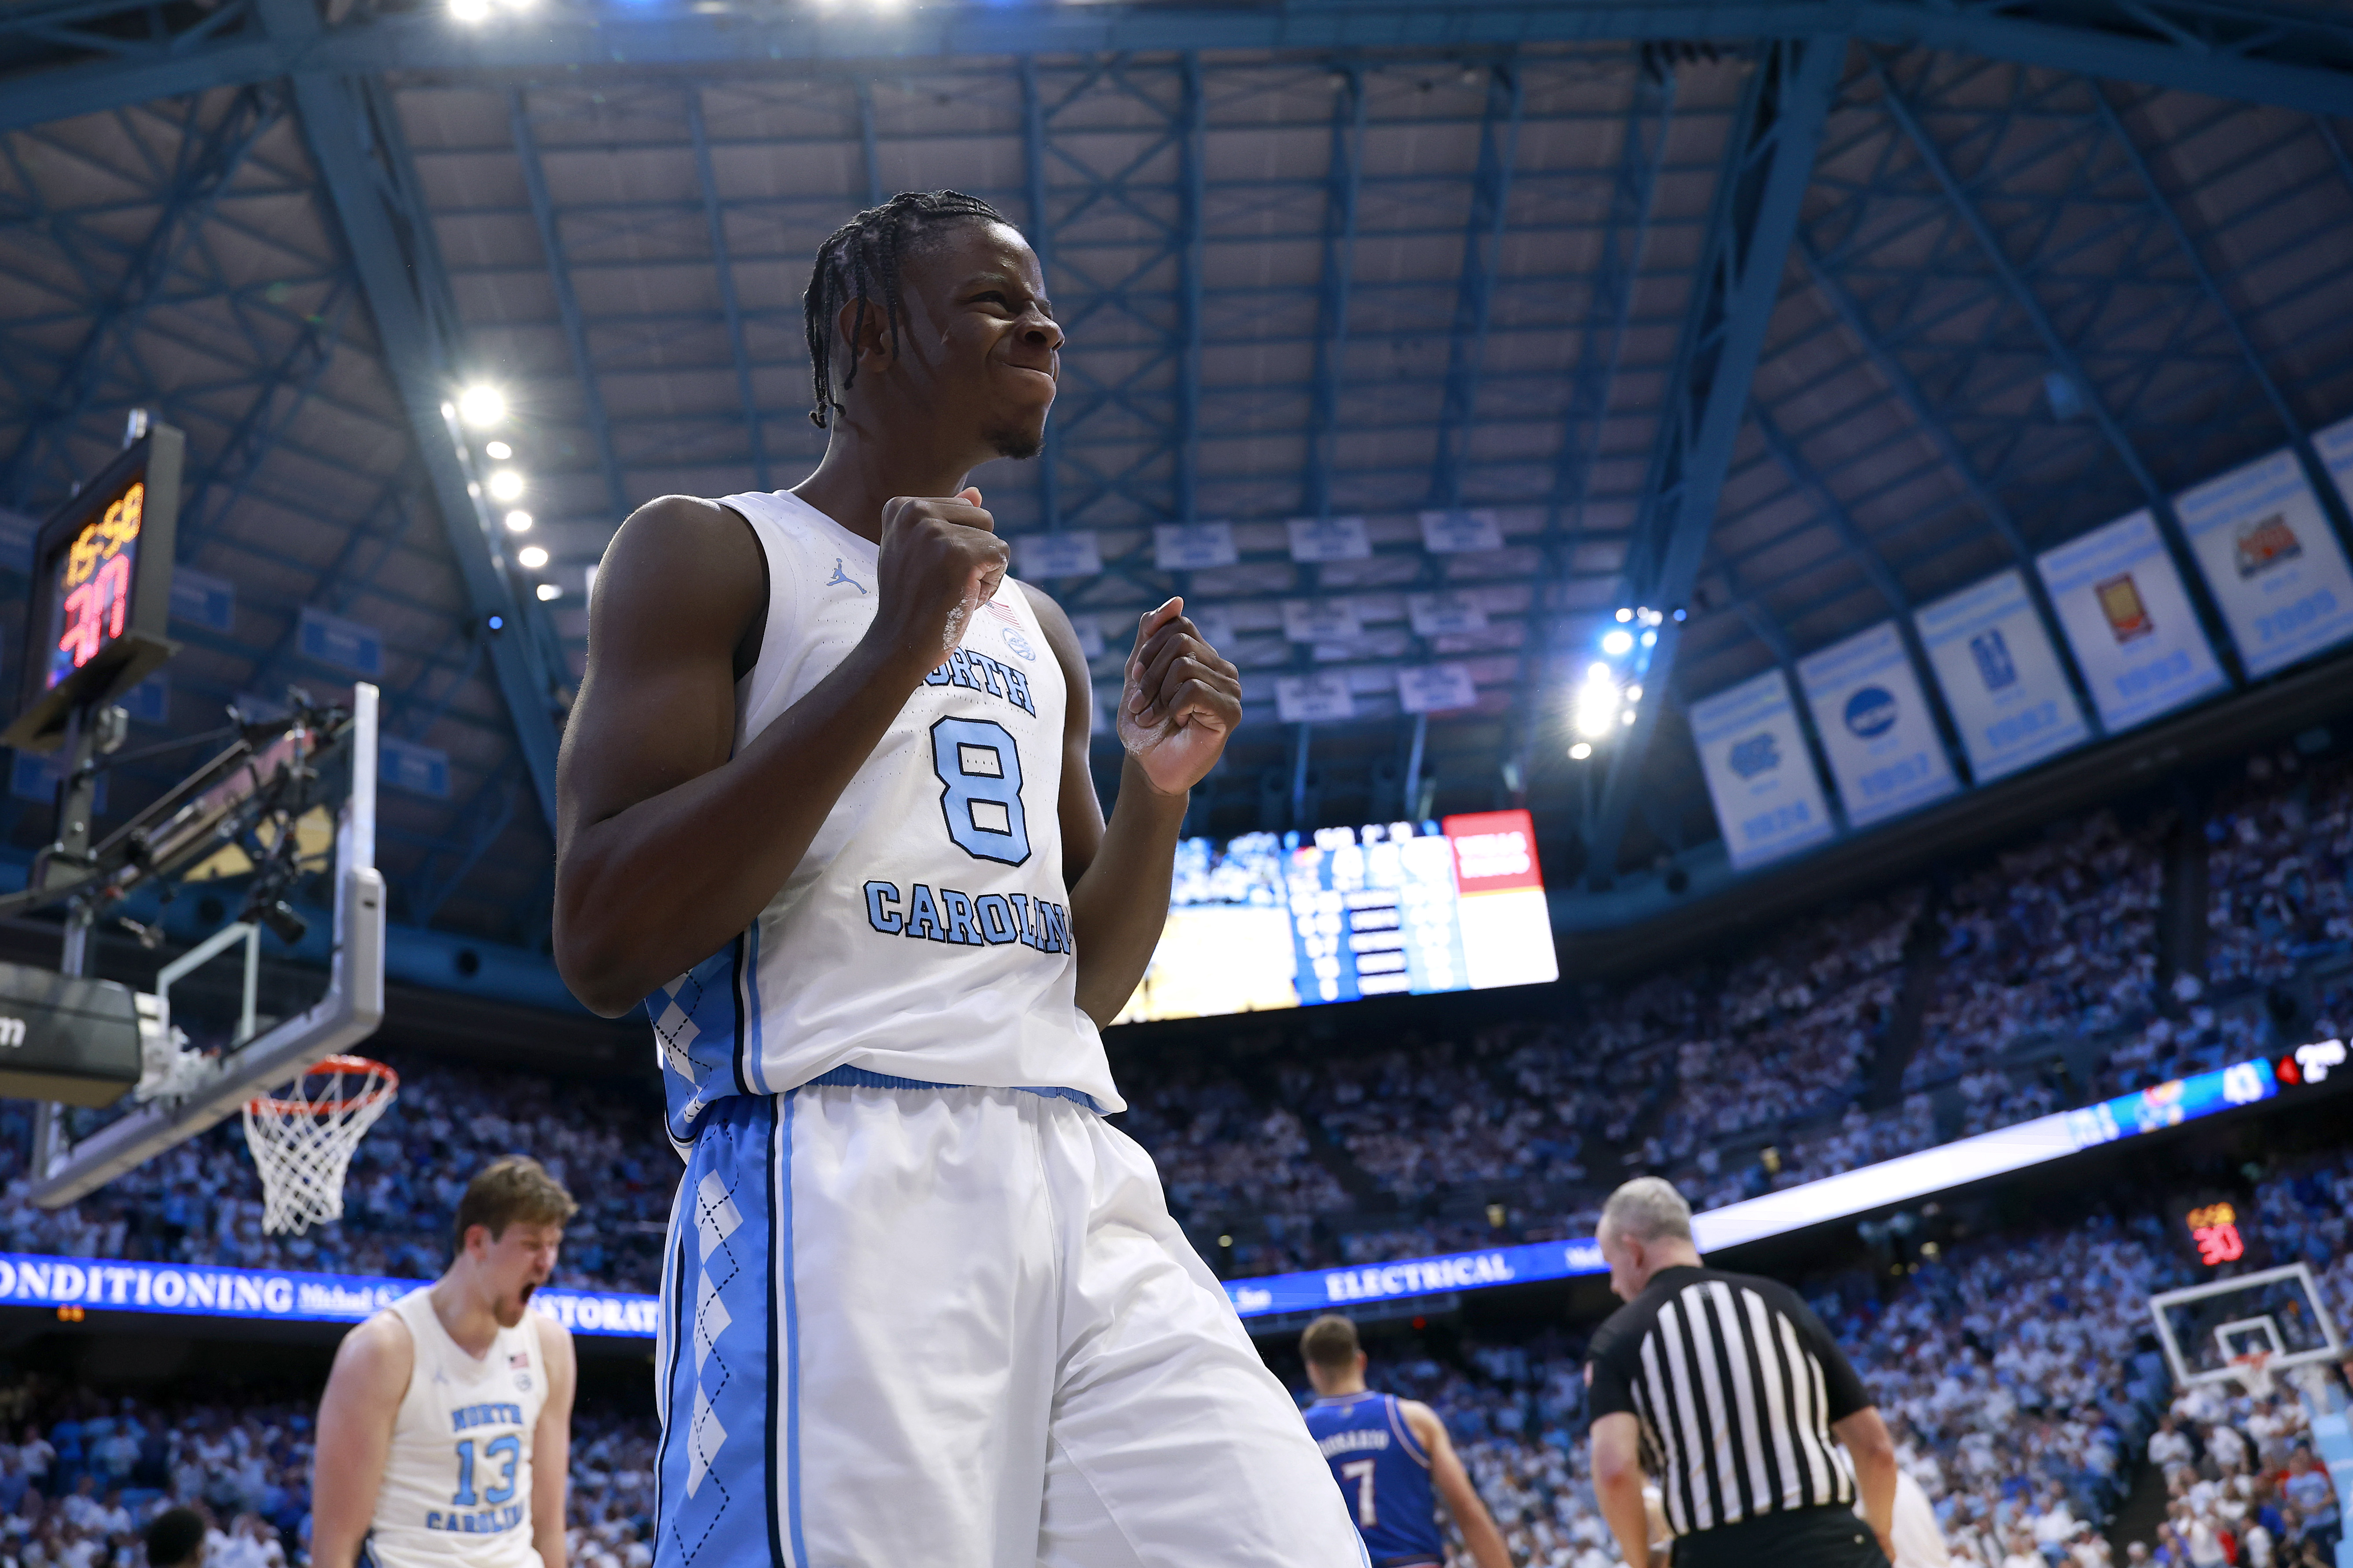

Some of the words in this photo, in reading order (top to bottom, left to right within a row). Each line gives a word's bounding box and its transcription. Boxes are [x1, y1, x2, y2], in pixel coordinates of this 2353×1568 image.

[919, 646, 1036, 718] ORTH
[930, 714, 1032, 867] 8
[863, 880, 1073, 955] CAROLIN
[1325, 1253, 1516, 1302] ELECTRICAL
[2193, 1223, 2244, 1265] 30
[451, 1402, 522, 1433] NORTH
[453, 1435, 520, 1506] 13
[1342, 1458, 1377, 1527] 7
